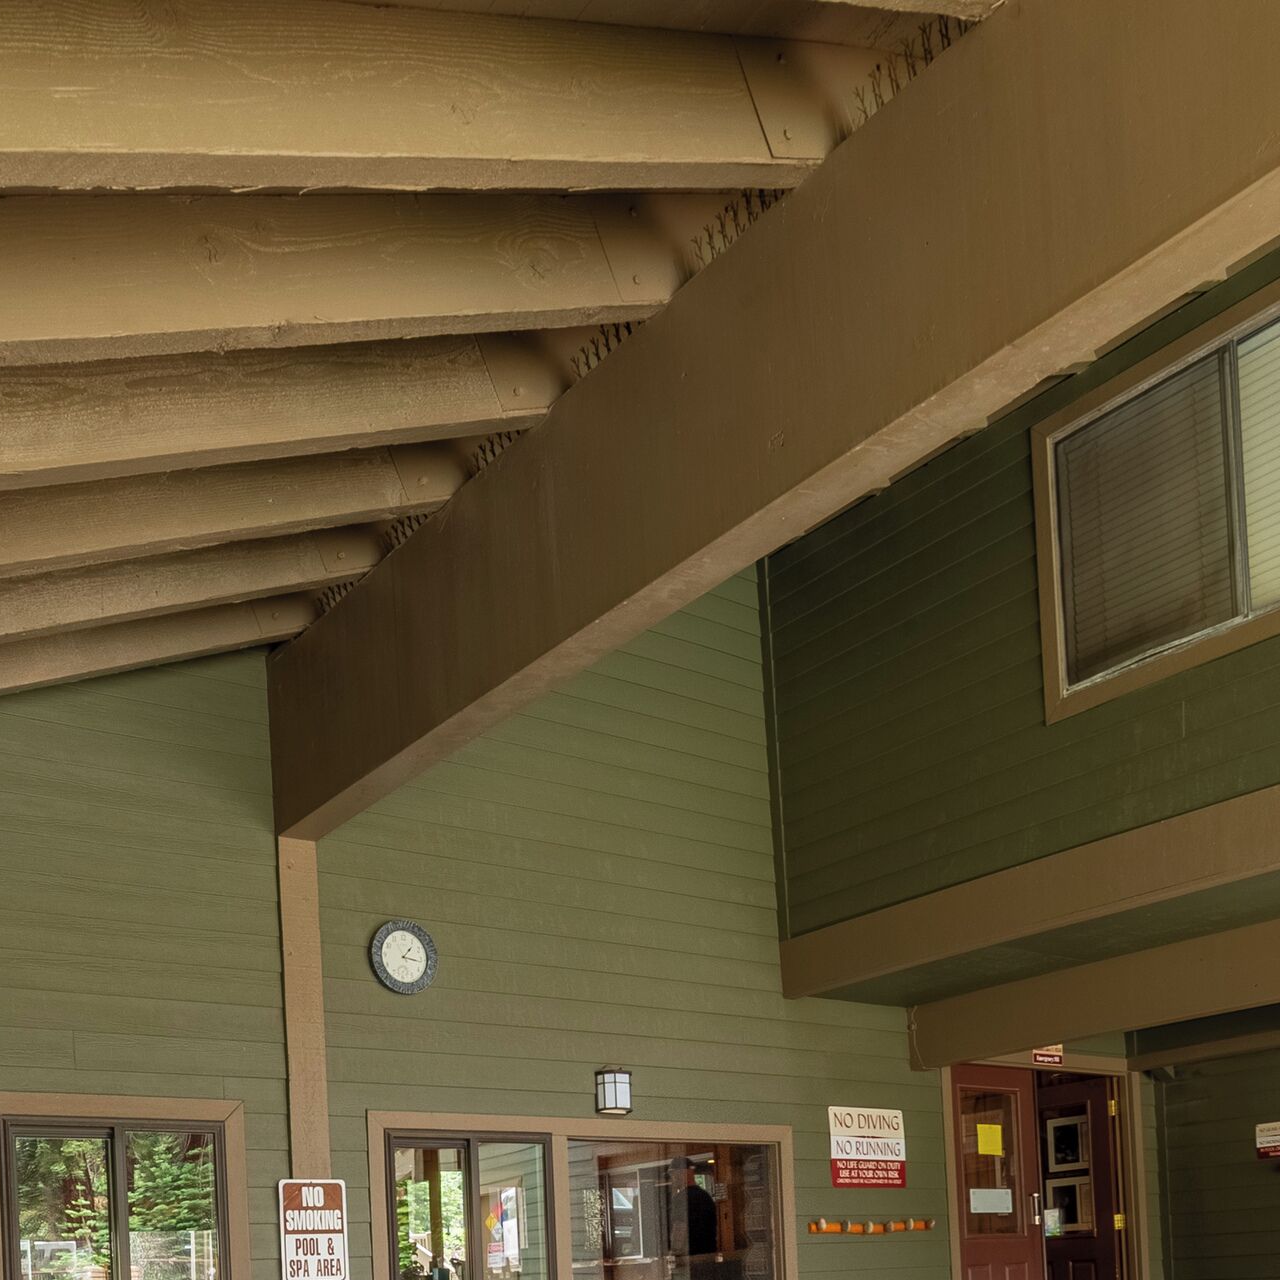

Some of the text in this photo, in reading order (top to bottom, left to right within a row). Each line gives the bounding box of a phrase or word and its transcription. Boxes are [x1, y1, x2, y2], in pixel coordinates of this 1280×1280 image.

[833, 1112, 900, 1131] NO DIVING
[836, 1140, 901, 1157] NO RUNNING
[837, 1161, 901, 1170] NO LIFE GUARD ON DUTY
[839, 1170, 850, 1178] USE
[851, 1170, 858, 1178] AT
[859, 1170, 873, 1178] YOUR
[874, 1170, 887, 1178] OWN
[301, 1186, 324, 1207] NO
[286, 1209, 342, 1231] SMOKING
[295, 1237, 335, 1256] POOL &
[289, 1258, 342, 1278] SPA AREA
